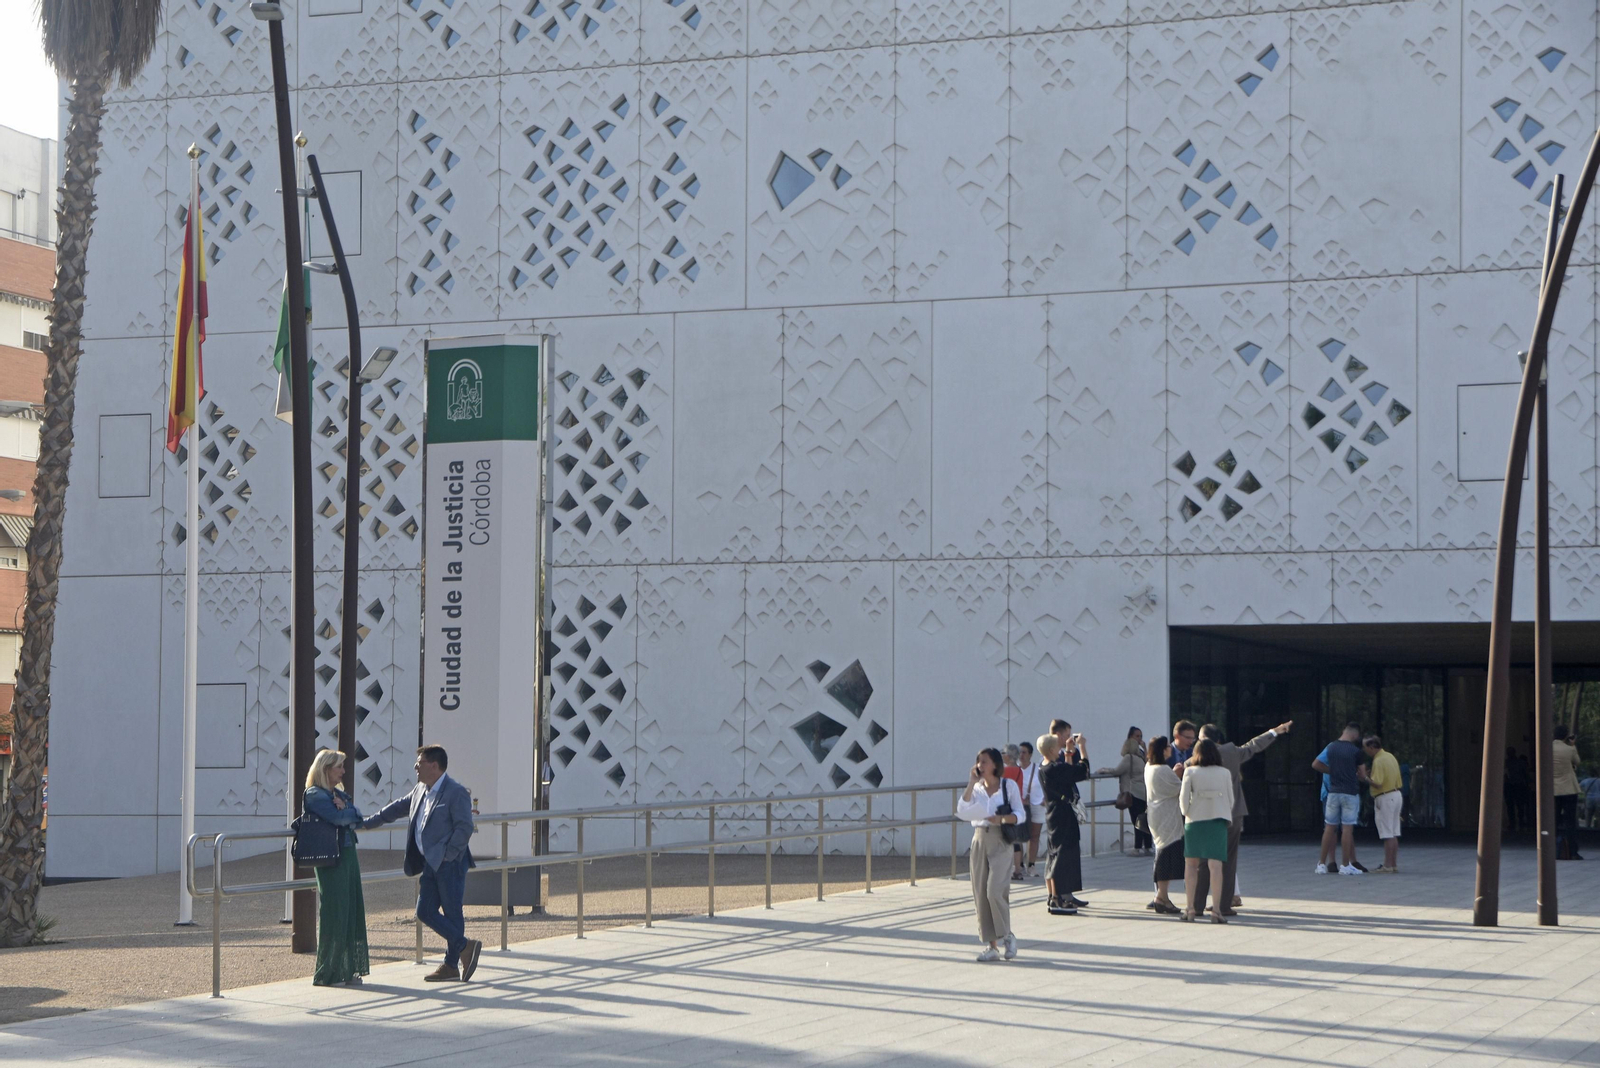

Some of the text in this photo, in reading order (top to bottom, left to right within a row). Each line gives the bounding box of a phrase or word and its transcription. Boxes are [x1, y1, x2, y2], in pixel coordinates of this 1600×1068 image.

[439, 460, 464, 711] Ciudad de la Justicia
[468, 458, 491, 546] Córdoba
